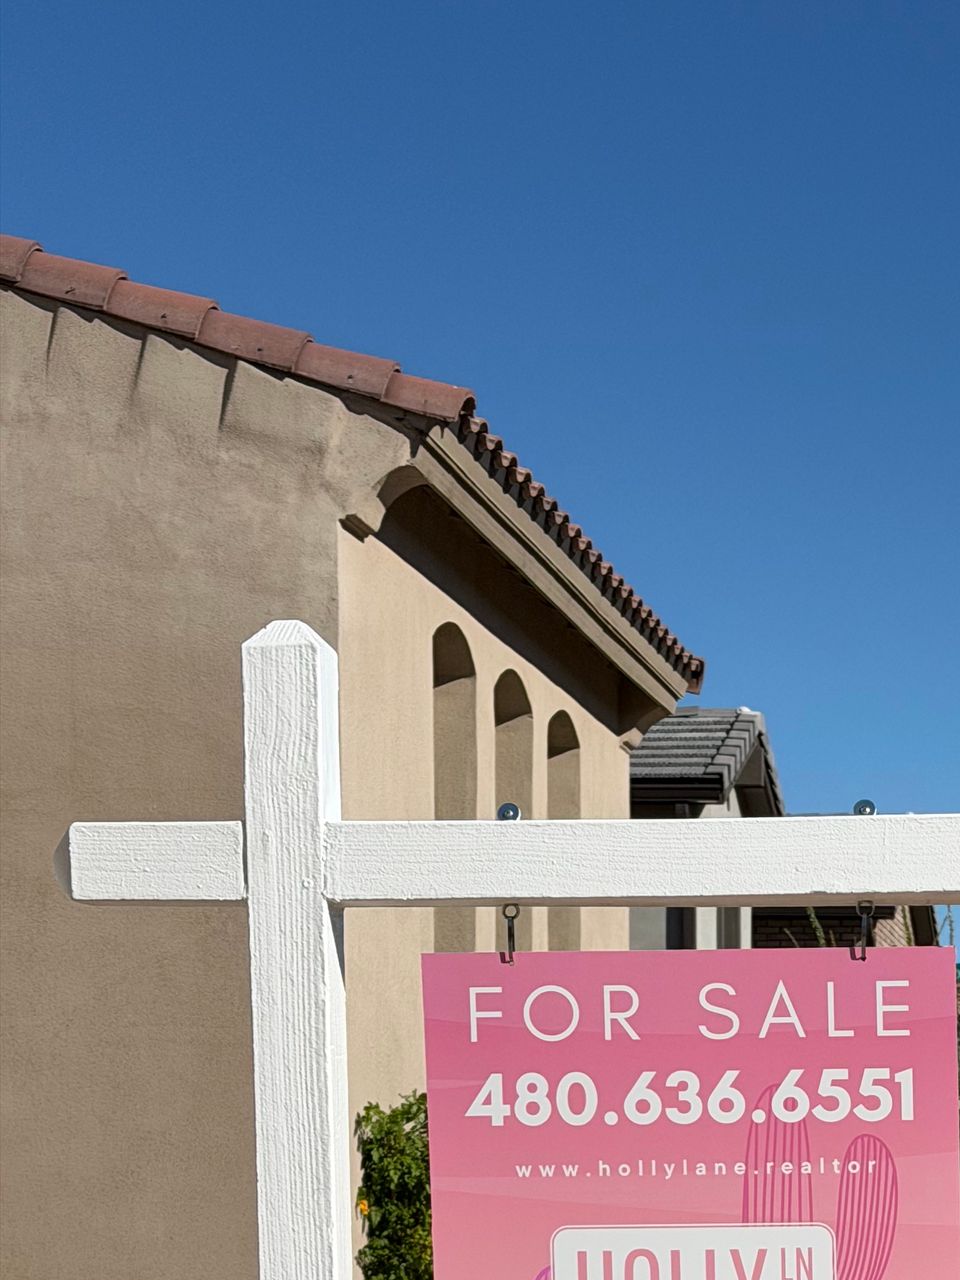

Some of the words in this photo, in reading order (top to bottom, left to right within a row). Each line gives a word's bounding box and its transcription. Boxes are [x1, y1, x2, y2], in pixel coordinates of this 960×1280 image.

[470, 985, 641, 1042] FOR
[698, 981, 911, 1039] SALE
[464, 1068, 914, 1127] 480.636.6551
[515, 1157, 877, 1180] www.hollylane.realtor
